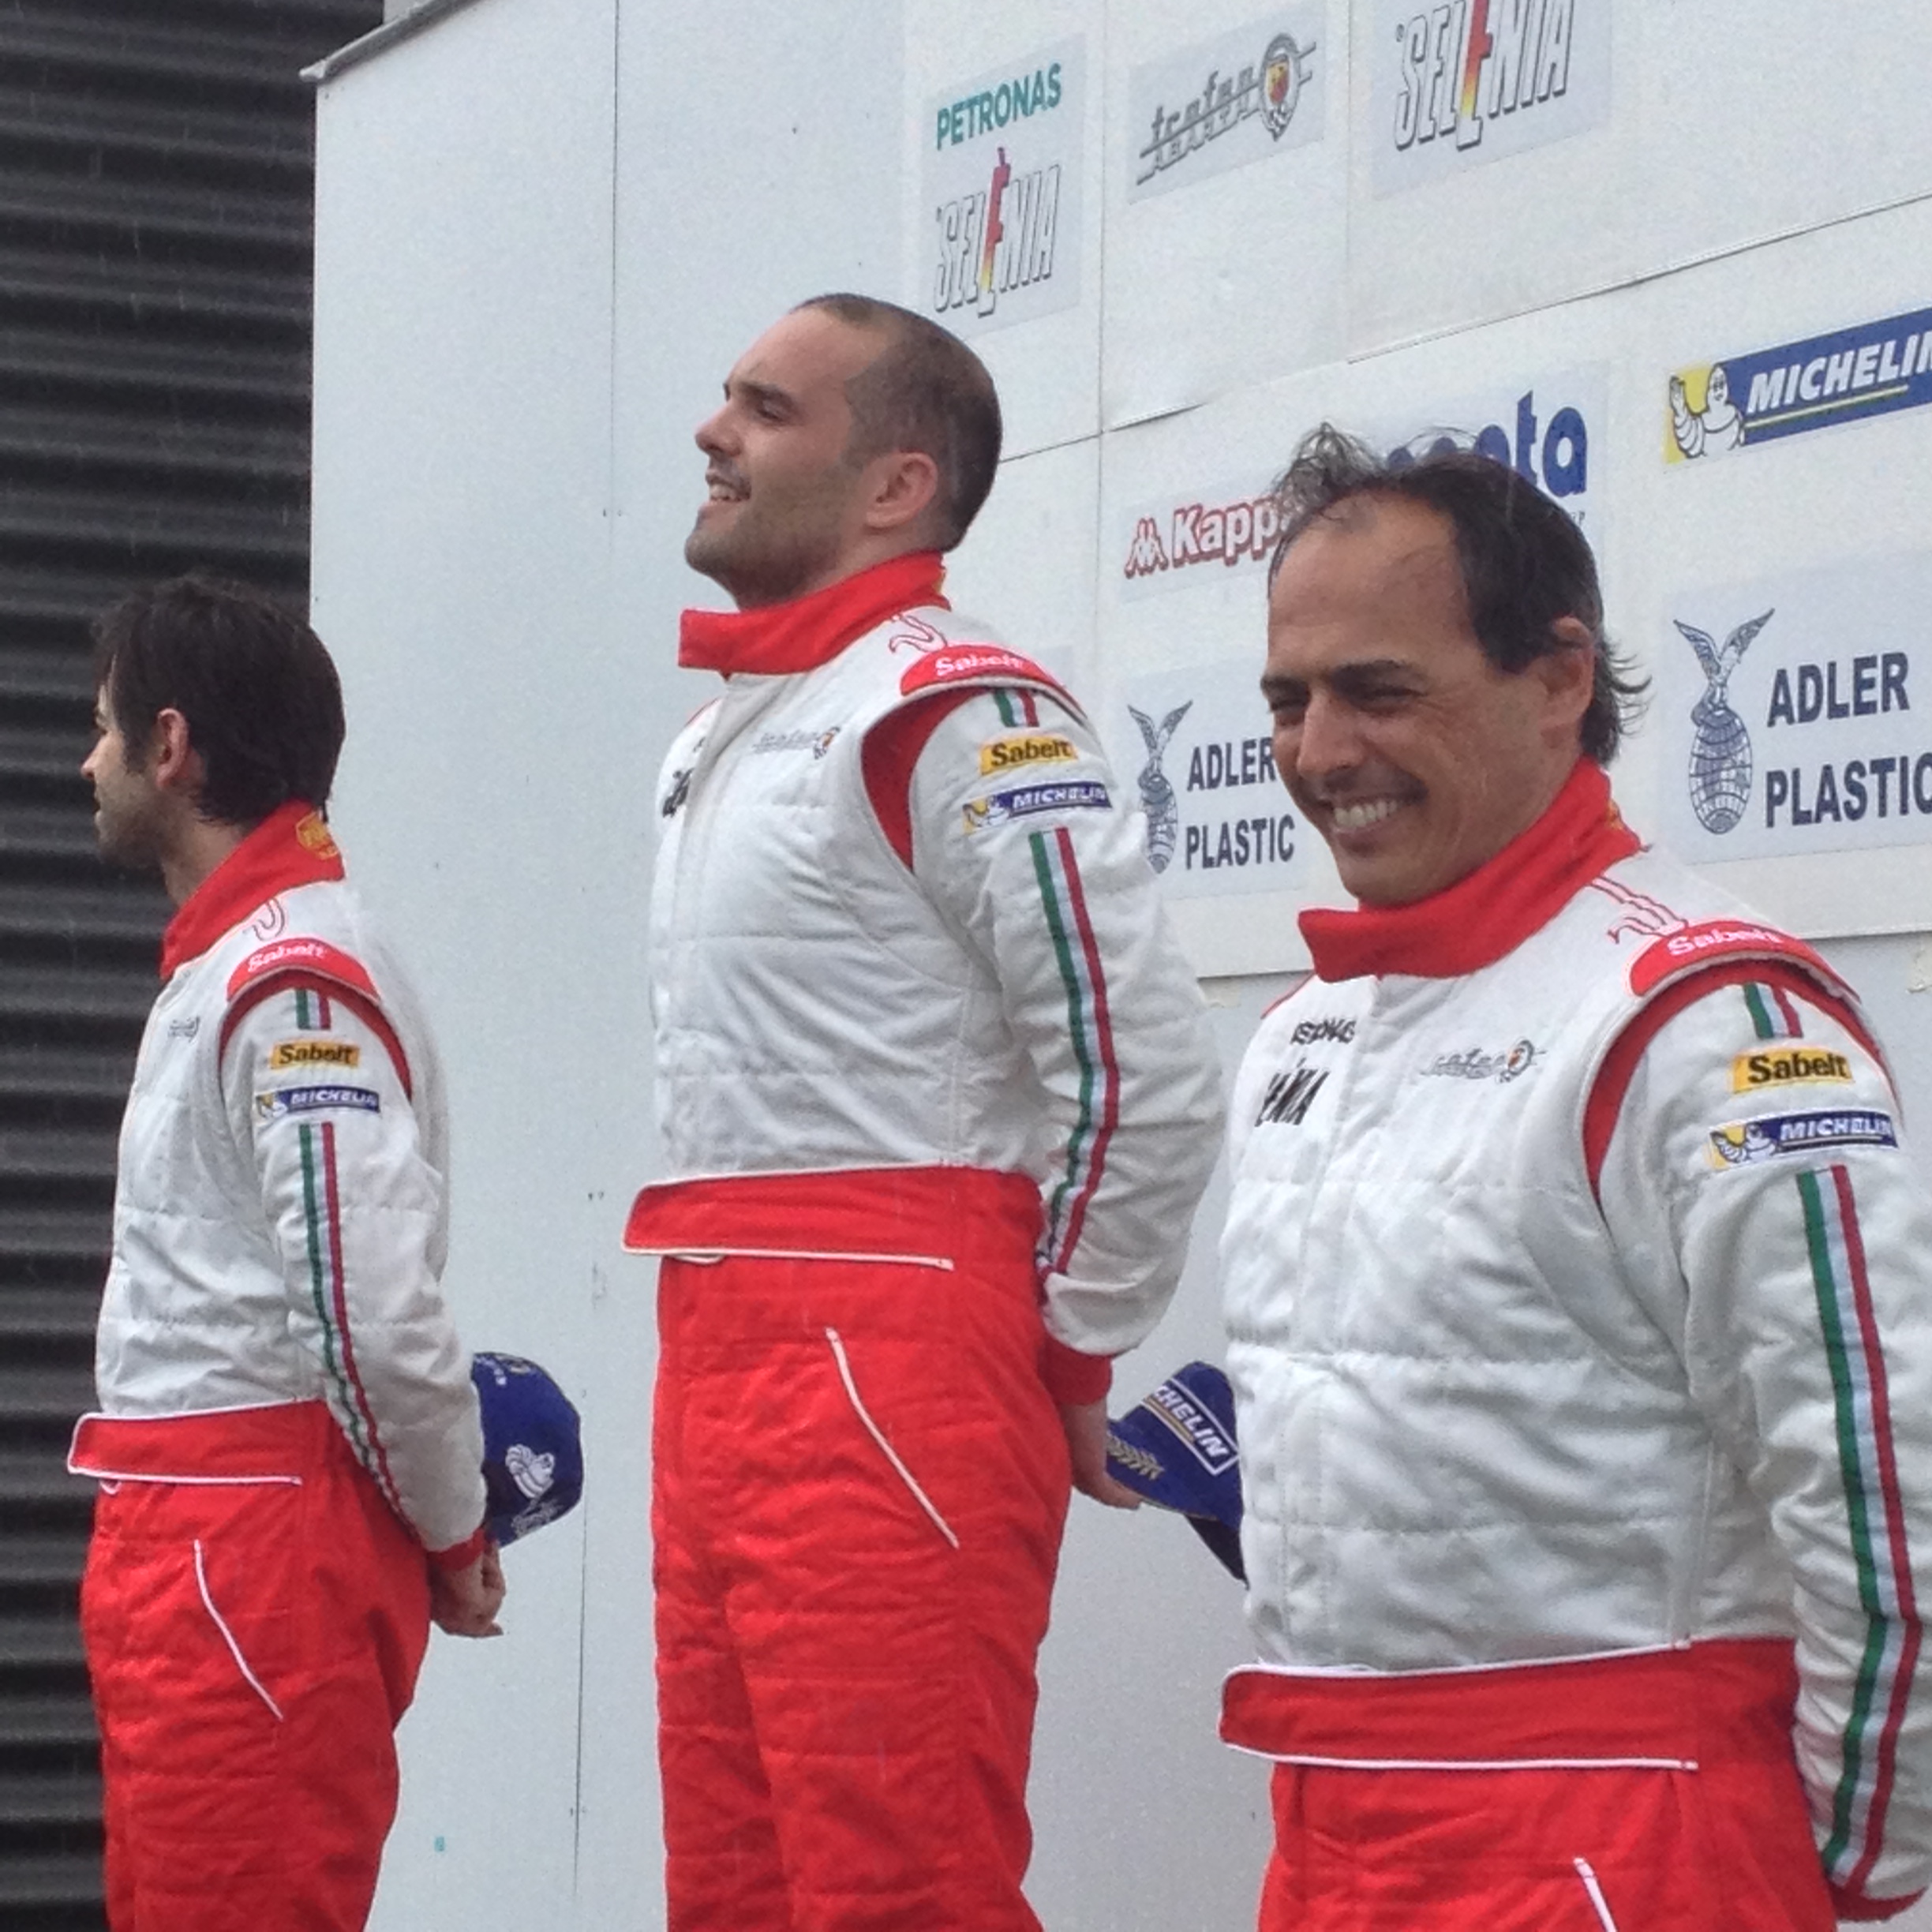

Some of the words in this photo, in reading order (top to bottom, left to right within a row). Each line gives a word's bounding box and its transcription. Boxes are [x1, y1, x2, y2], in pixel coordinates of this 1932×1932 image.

[936, 62, 1061, 151] PETRONAS
[934, 147, 1061, 318] SELENIA
[1172, 495, 1293, 568] Kapp
[1766, 651, 1911, 728] ADLER
[990, 740, 1074, 767] Sabelt
[1186, 736, 1277, 792] ADLER
[1012, 788, 1105, 809] MICHELIN
[1765, 752, 1932, 828] PLASTIC
[1185, 813, 1296, 871] PLASTIC
[279, 1044, 353, 1065] Sabelt
[1747, 1053, 1849, 1084] Sabelt
[290, 1089, 378, 1106] MICHELIN
[1780, 1118, 1892, 1141] MICHELIN
